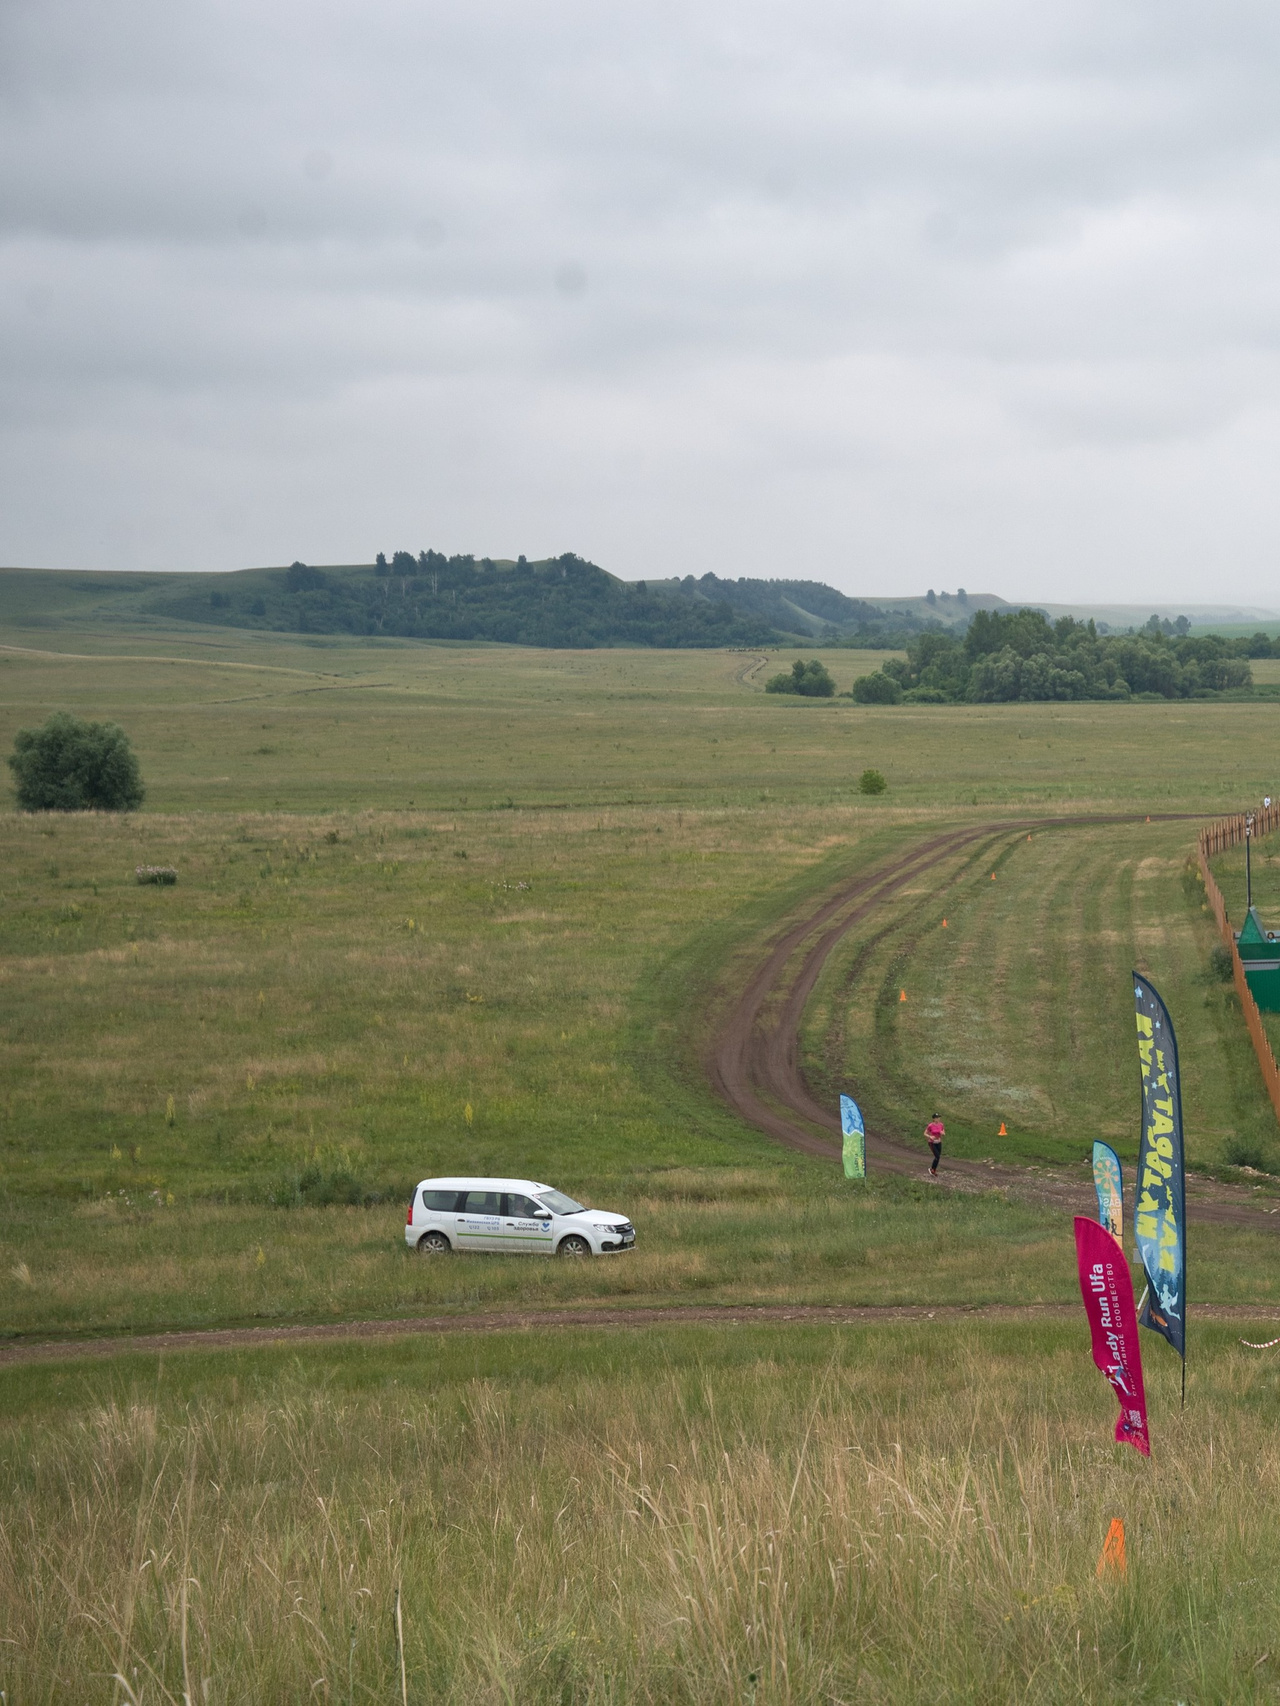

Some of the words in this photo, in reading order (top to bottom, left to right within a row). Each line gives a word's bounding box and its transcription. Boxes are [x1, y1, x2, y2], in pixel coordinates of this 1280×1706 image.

[1089, 1264, 1106, 1292] Ufa
[1106, 1263, 1123, 1328] СООБЩЕСТВО
[1097, 1296, 1113, 1327] Run
[1105, 1331, 1124, 1371] Lady
